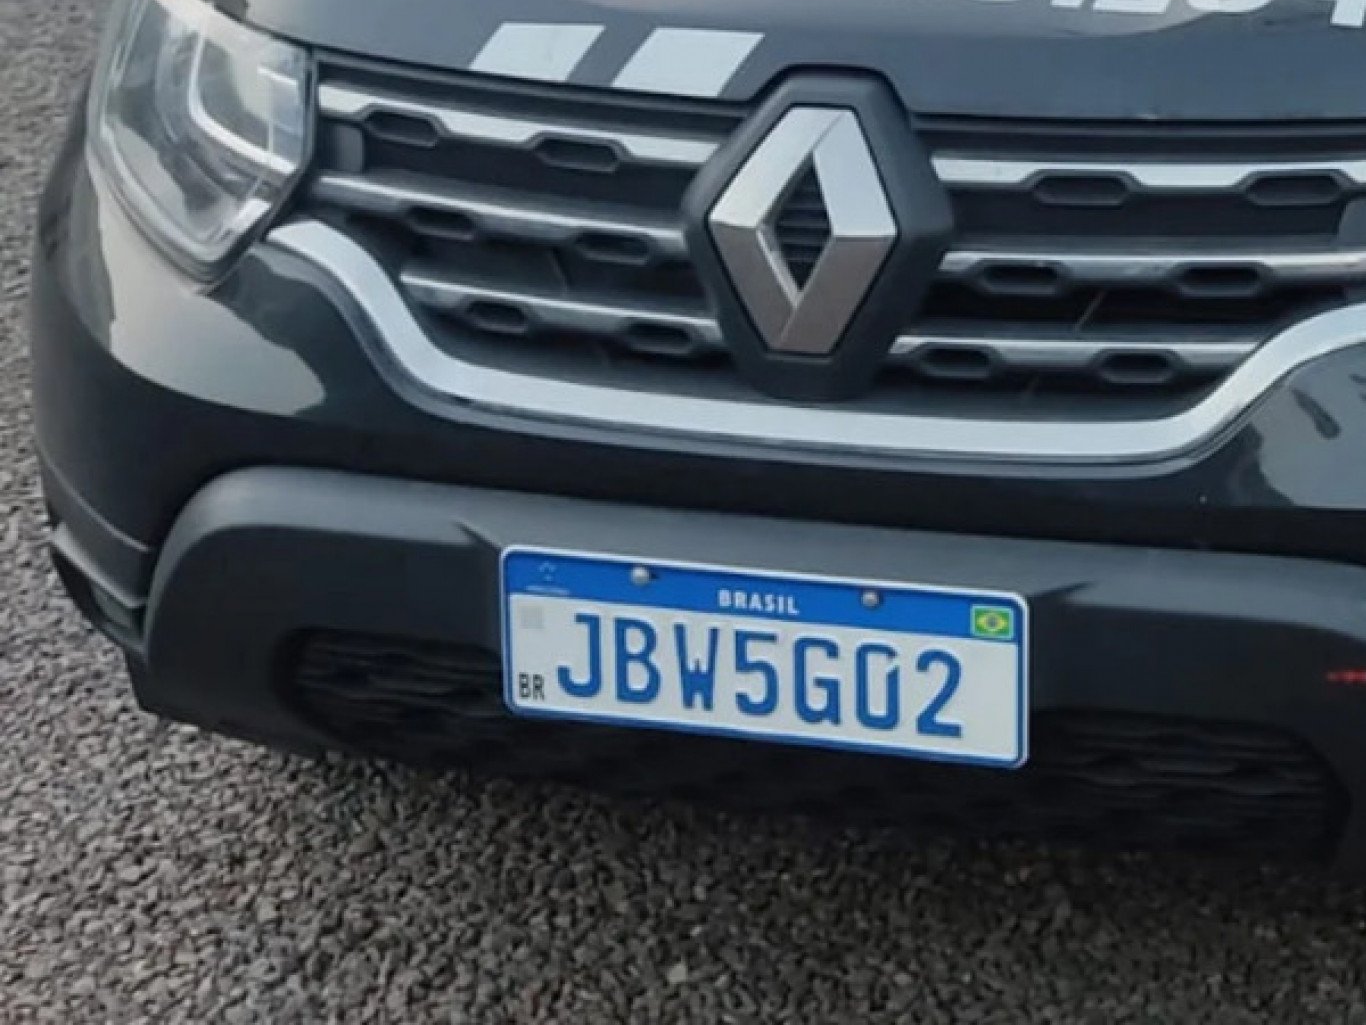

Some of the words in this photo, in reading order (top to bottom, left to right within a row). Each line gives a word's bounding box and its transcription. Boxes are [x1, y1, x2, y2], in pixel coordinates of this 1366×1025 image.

[717, 588, 800, 615] BRASIL
[518, 672, 546, 701] BR
[556, 611, 963, 739] JBW5G02
